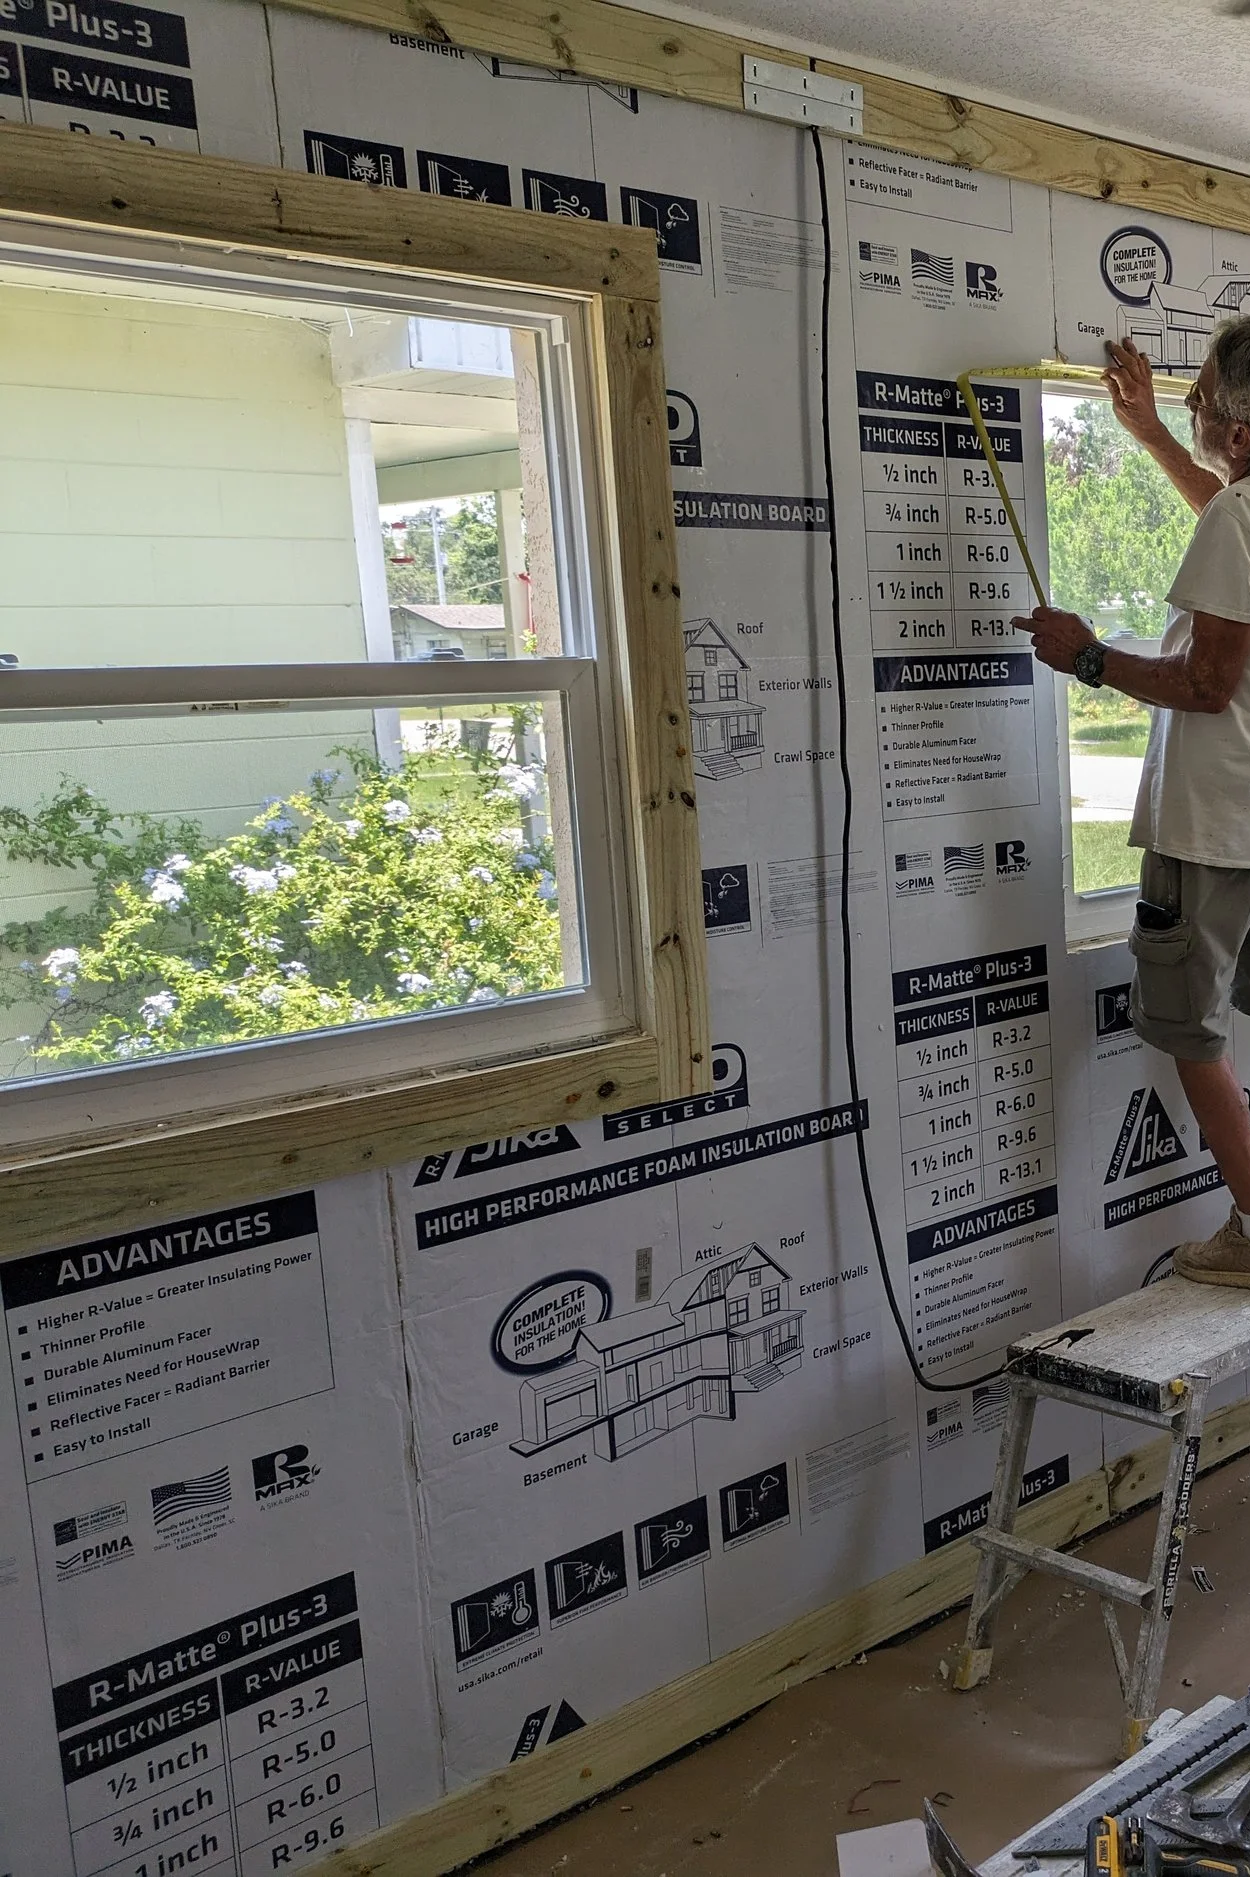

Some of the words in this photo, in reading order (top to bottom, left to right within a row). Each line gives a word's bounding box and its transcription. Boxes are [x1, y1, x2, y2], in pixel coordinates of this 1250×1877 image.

[45, 0, 153, 48] Plus-3
[389, 32, 465, 60] Basement
[52, 66, 171, 111] R-VALUE
[859, 158, 897, 175] Reflective
[898, 166, 919, 180] Facer
[925, 172, 953, 187] Radiant
[955, 179, 978, 193] Barrier
[860, 179, 878, 194] Easy
[880, 185, 888, 195] to
[889, 185, 913, 199] Install
[1112, 246, 1156, 261] COMPLETE
[1113, 259, 1157, 273] INSULATION!
[1221, 259, 1239, 272] Attic
[1114, 274, 1127, 285] FOR
[1127, 273, 1139, 282] THE
[1139, 270, 1157, 282] HOME
[1077, 321, 1105, 338] Garage
[863, 426, 939, 447] THICKNESS
[673, 500, 763, 521] SULATION
[768, 503, 826, 523] BOARD
[966, 506, 1007, 526] R-5.0
[967, 544, 1009, 563] R-6.0
[969, 582, 1010, 600] R-9.6
[736, 622, 764, 635] Roof
[972, 619, 1016, 637] R-13.1
[758, 680, 800, 692] Exterior
[803, 677, 833, 690] Walls
[901, 660, 1010, 684] ADVANTAGES
[774, 751, 802, 764] Crawl
[805, 749, 835, 764] Space
[892, 740, 920, 751] Durable
[921, 738, 958, 750] Aluminum
[958, 736, 977, 746] Facer
[894, 758, 931, 770] Eliminates
[932, 756, 951, 767] Need
[951, 755, 962, 765] for
[962, 753, 1002, 765] HouseWrap
[908, 876, 934, 889] PIMA
[985, 954, 1032, 980] Plus-3
[898, 1007, 971, 1036] THICKNESS
[986, 992, 1039, 1016] R-VALUE
[992, 1025, 1032, 1048] R-3.2
[618, 1094, 736, 1134] SELECT
[1132, 1113, 1177, 1168] Sika
[425, 1203, 479, 1238] HIGH
[486, 1165, 639, 1223] PERFORMANCE
[643, 1150, 696, 1180] FOAM
[701, 1124, 806, 1166] INSULATION
[999, 1158, 1042, 1185] R-13.1
[1108, 1200, 1136, 1222] HIGH
[1139, 1170, 1219, 1210] PERFORMANCE
[931, 1199, 1036, 1249] ADVANTAGES
[57, 1211, 272, 1287] ADVANTAGES
[695, 1245, 722, 1263] Attic
[779, 1233, 806, 1250] Roof
[37, 1308, 85, 1332] Higher
[88, 1293, 143, 1319] R-Value
[157, 1277, 205, 1300] Greater
[207, 1260, 272, 1287] Insulating
[274, 1250, 312, 1270] Power
[799, 1275, 839, 1297] Exterior
[840, 1263, 869, 1282] Walls
[512, 1284, 586, 1333] COMPLETE
[40, 1332, 96, 1357] Thinner
[99, 1318, 146, 1340] Profile
[513, 1301, 586, 1347] INSULATION!
[514, 1342, 537, 1361] FOR
[537, 1333, 558, 1352] THE
[558, 1314, 587, 1342] HOME
[43, 1356, 99, 1382] Durable
[102, 1336, 174, 1365] Aluminum
[177, 1325, 212, 1345] Facer
[813, 1339, 841, 1359] Crawl
[842, 1330, 872, 1349] Space
[53, 1437, 87, 1459] Easy
[90, 1433, 105, 1445] to
[108, 1417, 151, 1440] Install
[452, 1420, 500, 1447] Garage
[523, 1453, 588, 1488] Basement
[1180, 1453, 1196, 1521] LADDERS
[82, 1535, 134, 1564] PIMA
[240, 1593, 329, 1646] Plus-3
[458, 1647, 544, 1693] usa.sika.com/retail
[68, 1693, 211, 1768] THICKNESS
[245, 1639, 341, 1694] R-VALUE
[148, 1740, 209, 1784] inch
[257, 1686, 331, 1735] R-3.2
[153, 1786, 215, 1831] inch
[262, 1729, 336, 1780] R-5.0
[271, 1816, 345, 1869] R-9.6
